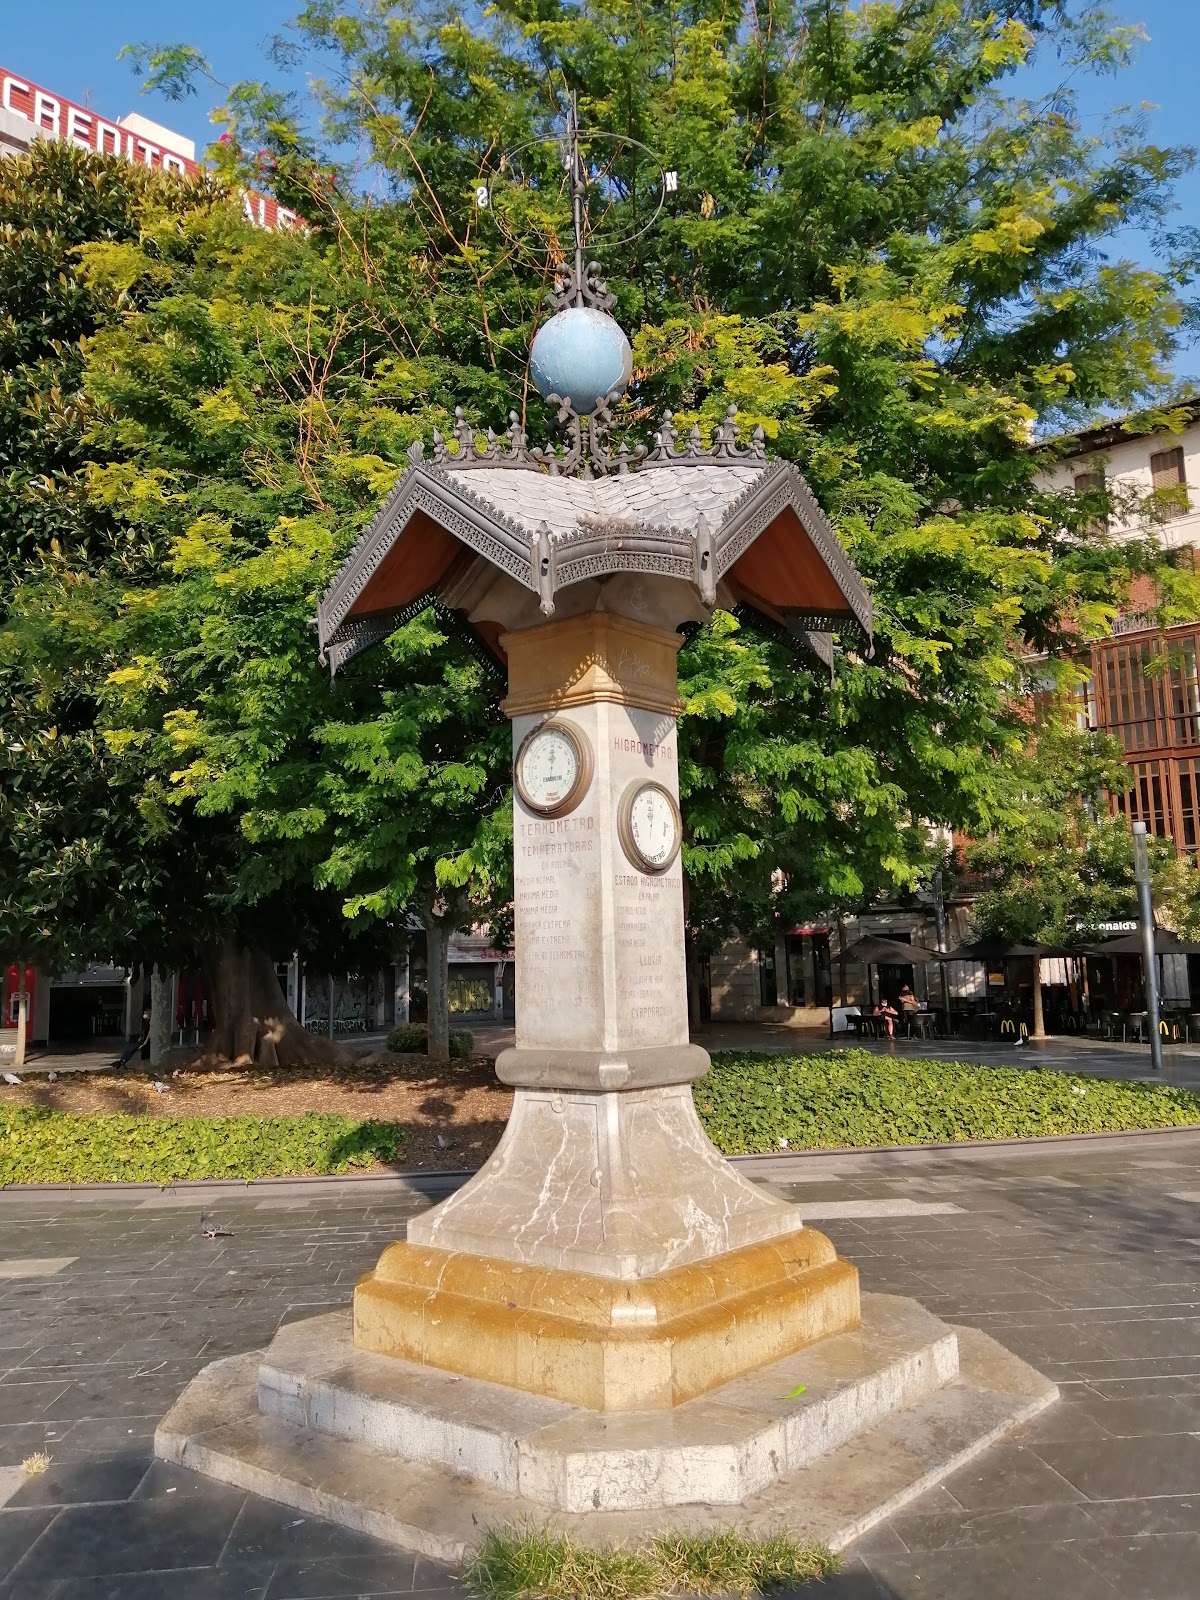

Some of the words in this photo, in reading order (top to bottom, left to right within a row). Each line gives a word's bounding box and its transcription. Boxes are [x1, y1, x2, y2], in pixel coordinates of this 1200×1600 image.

[665, 171, 678, 192] N
[614, 737, 672, 759] HIGROMETRO
[520, 816, 594, 837] TERMOMETRO
[522, 840, 593, 857] TEMPERATURAS
[615, 875, 638, 886] ESTADO
